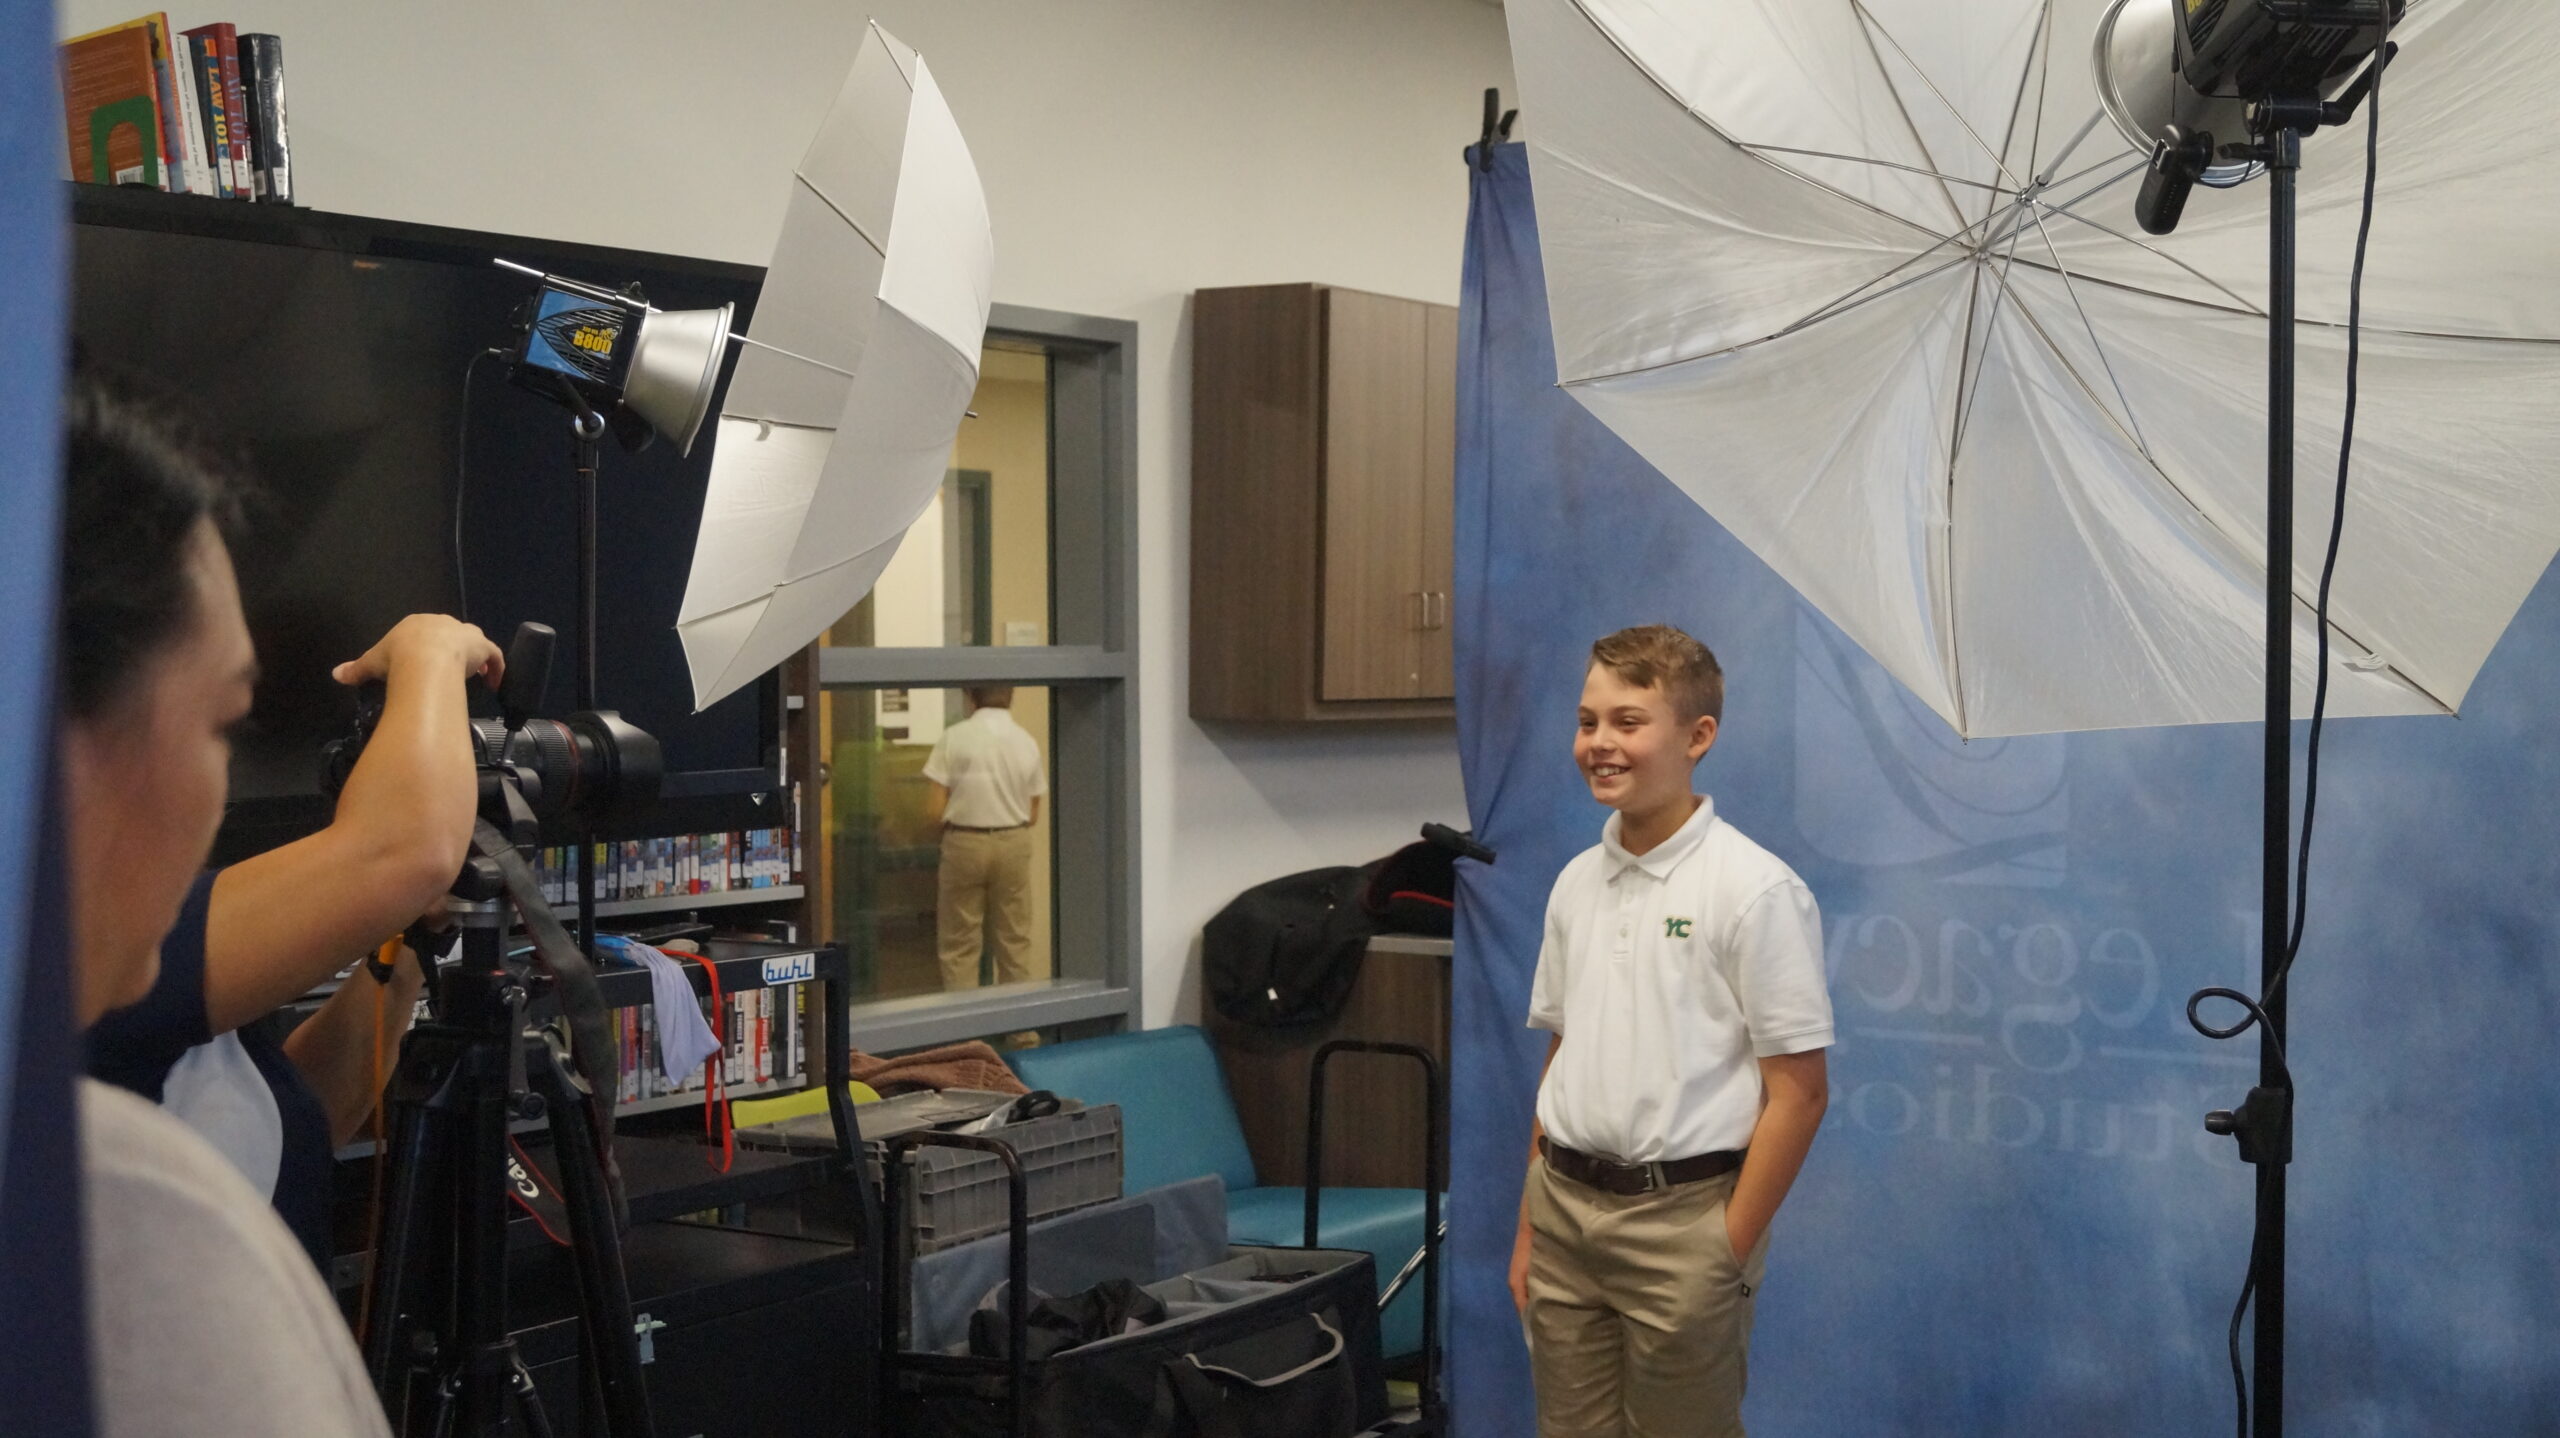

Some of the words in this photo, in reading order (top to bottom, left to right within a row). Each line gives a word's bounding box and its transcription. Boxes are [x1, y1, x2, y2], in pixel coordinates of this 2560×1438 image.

[209, 68, 223, 109] LAW
[225, 55, 241, 98] LAW
[214, 114, 229, 144] 101
[229, 110, 245, 145] 101
[574, 331, 612, 353] B800
[1666, 917, 1692, 938] YC
[765, 956, 812, 982] buhl
